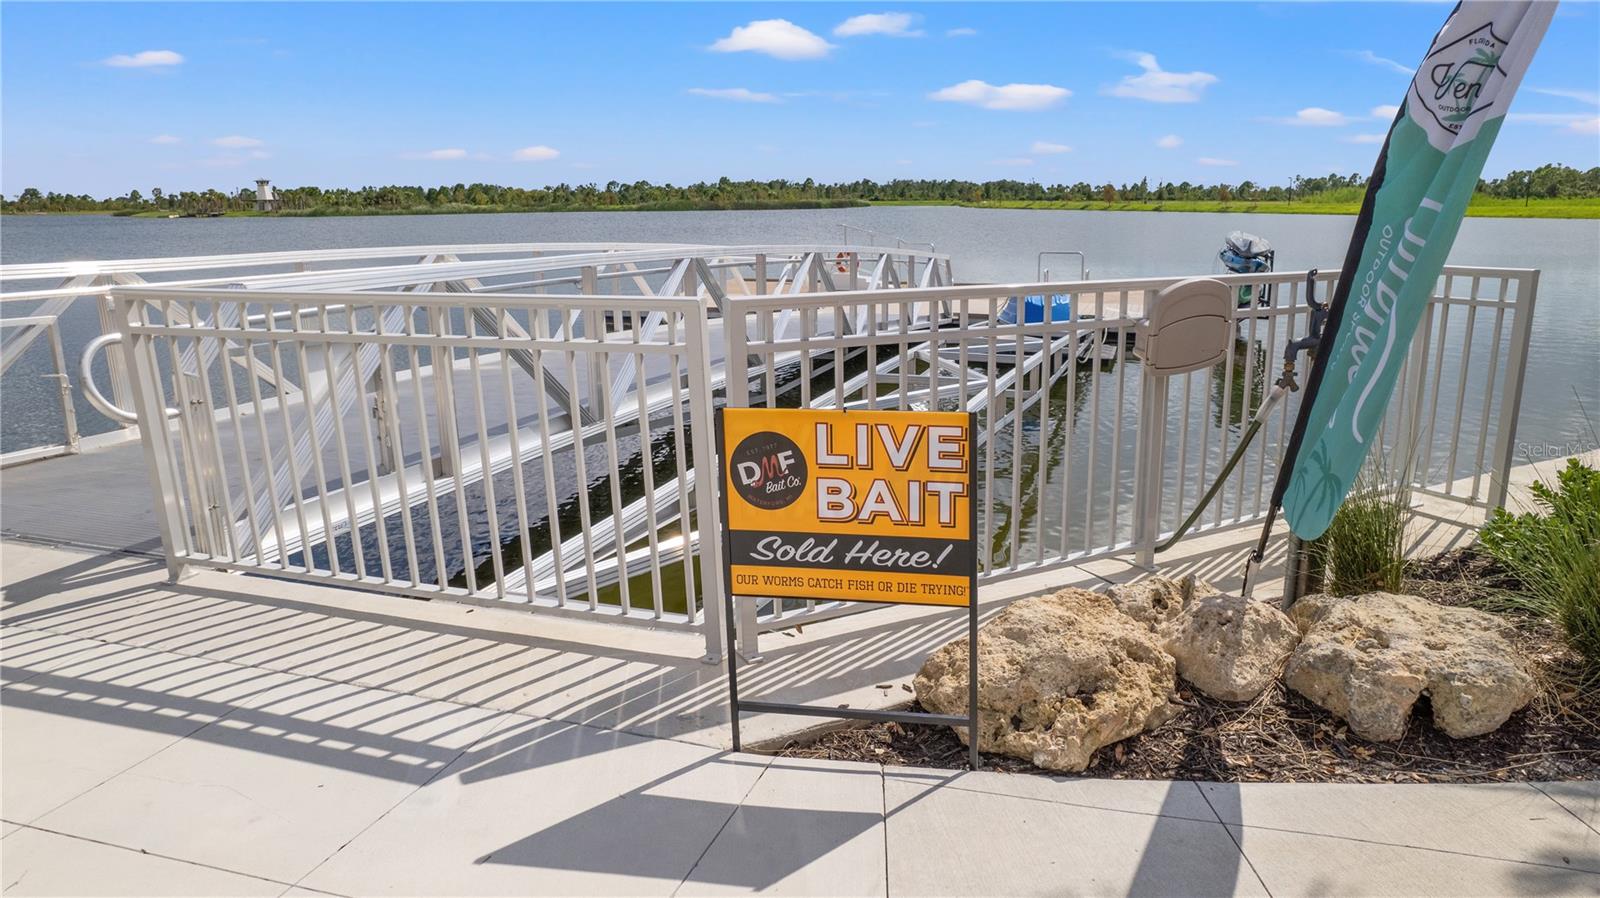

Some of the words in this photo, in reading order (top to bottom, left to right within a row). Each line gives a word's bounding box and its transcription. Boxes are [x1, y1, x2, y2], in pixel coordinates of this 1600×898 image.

[1469, 38, 1495, 48] FLORIDA
[1357, 224, 1393, 308] OUTDOOR
[815, 422, 968, 473] LIVE
[737, 450, 796, 488] DMF
[766, 481, 786, 493] Bait
[816, 476, 969, 528] BAIT
[750, 536, 838, 563] Sold
[844, 540, 953, 569] Here!
[736, 574, 759, 586] OUR
[763, 575, 804, 588] WORMS
[807, 577, 843, 590] CATCH
[847, 580, 874, 592] FISH
[877, 582, 893, 593] OR
[896, 583, 917, 595] DIE
[921, 584, 966, 597] TRYING!
